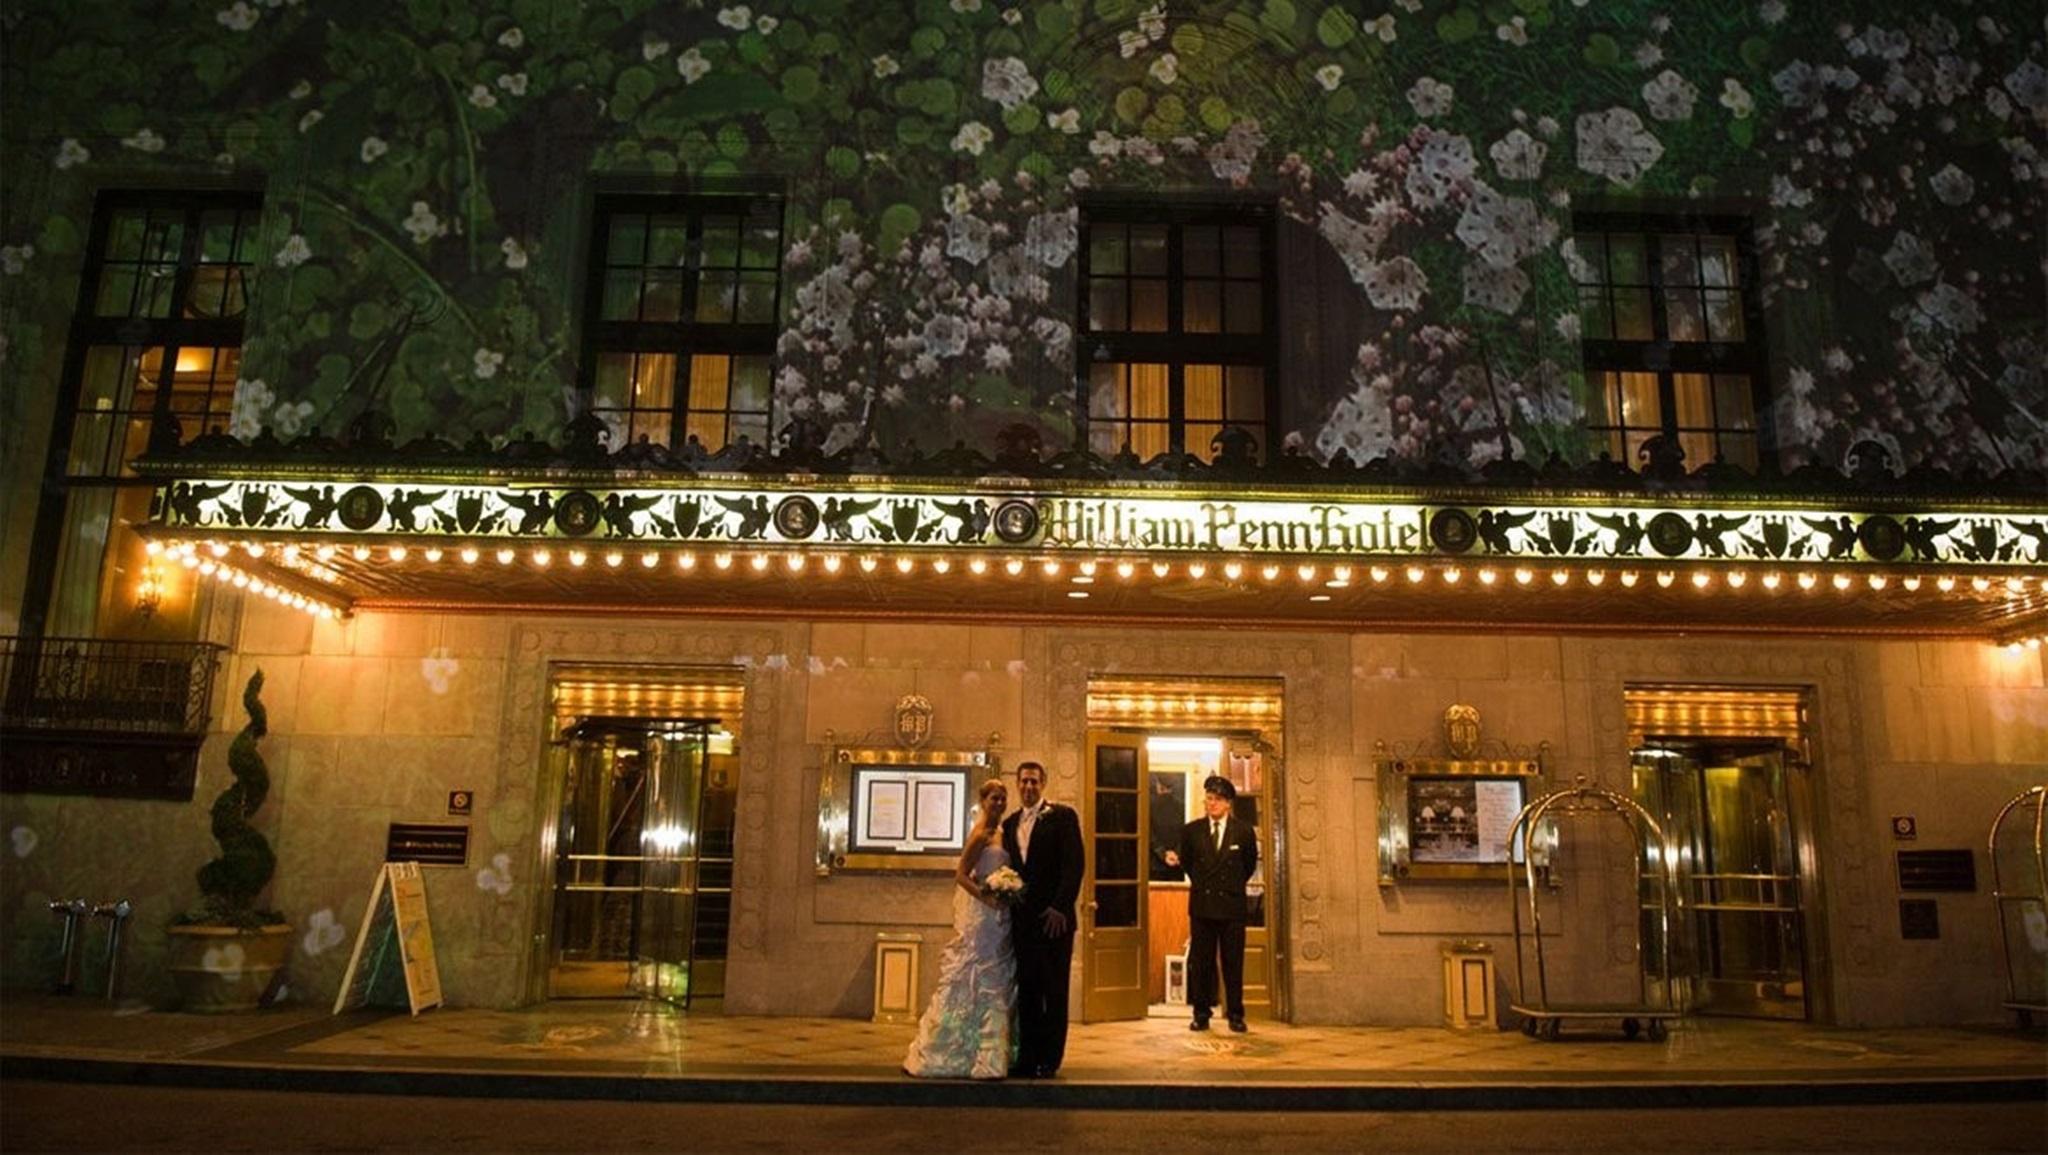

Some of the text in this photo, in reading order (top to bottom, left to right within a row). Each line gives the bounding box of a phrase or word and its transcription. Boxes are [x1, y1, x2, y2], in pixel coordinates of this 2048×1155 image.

[1040, 499, 1434, 552] William Penn Hotel
